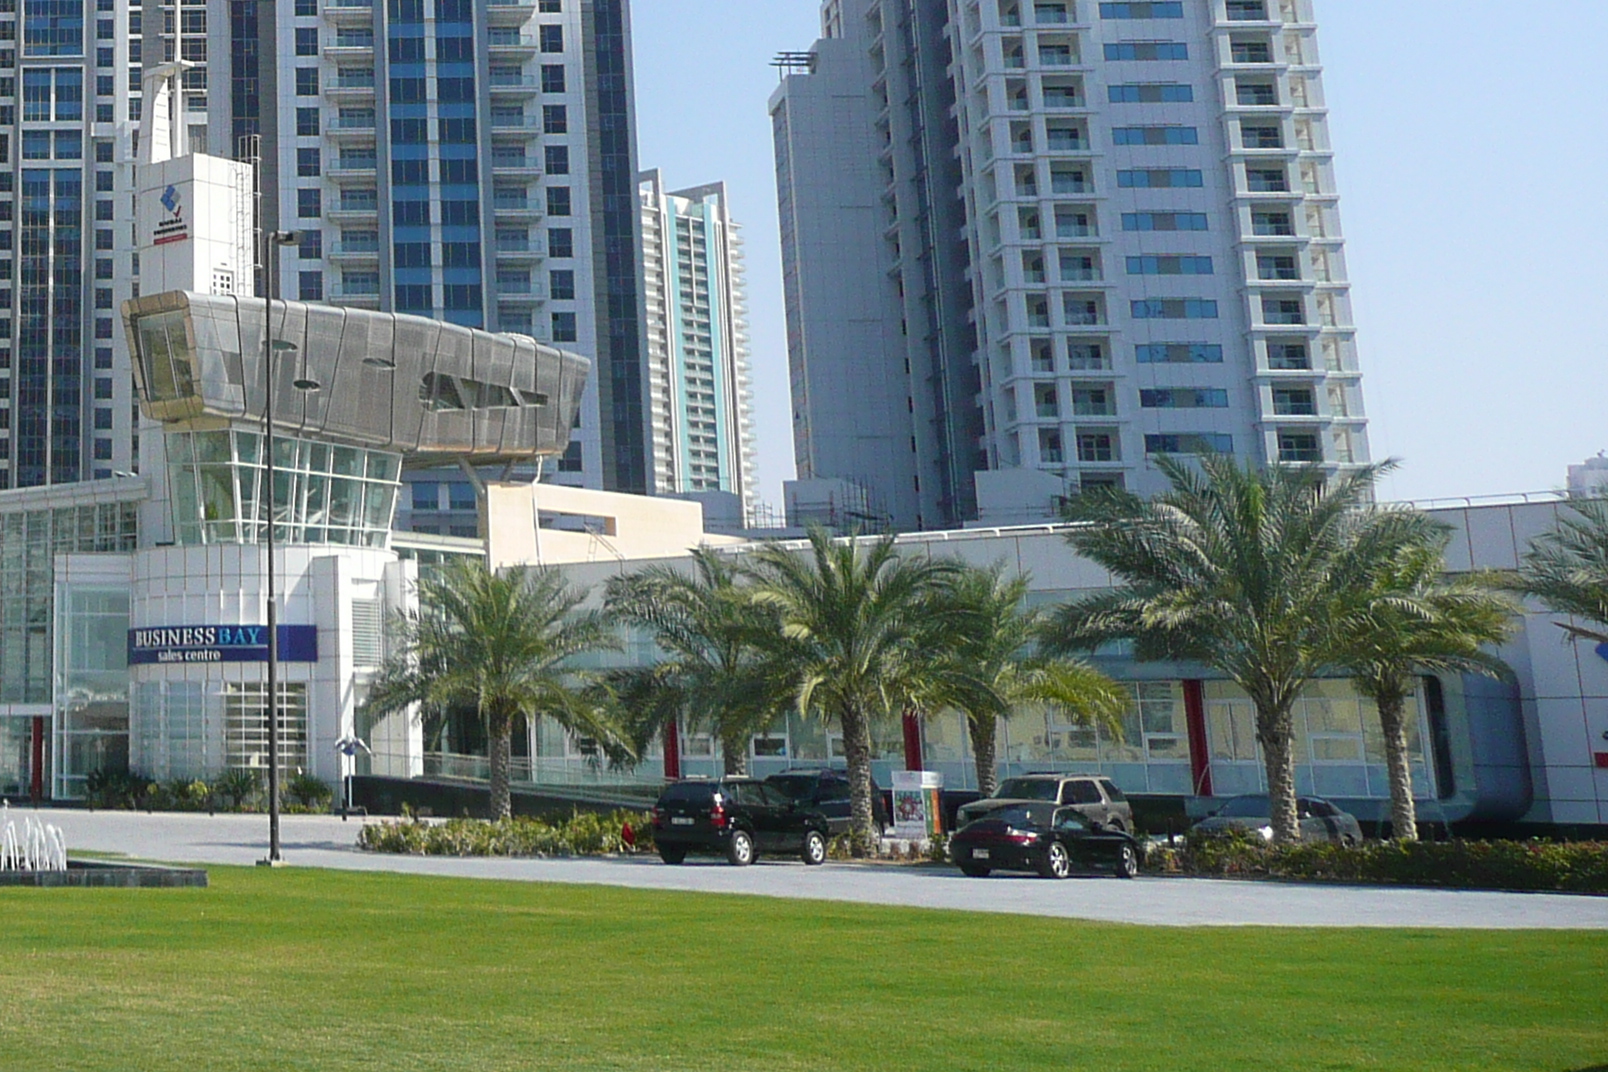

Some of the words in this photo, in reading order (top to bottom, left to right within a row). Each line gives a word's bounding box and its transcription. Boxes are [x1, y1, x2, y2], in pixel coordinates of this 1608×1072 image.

[135, 627, 216, 647] BUSINESS
[218, 627, 262, 644] BAY
[158, 648, 183, 662] sales
[185, 648, 221, 661] centre
